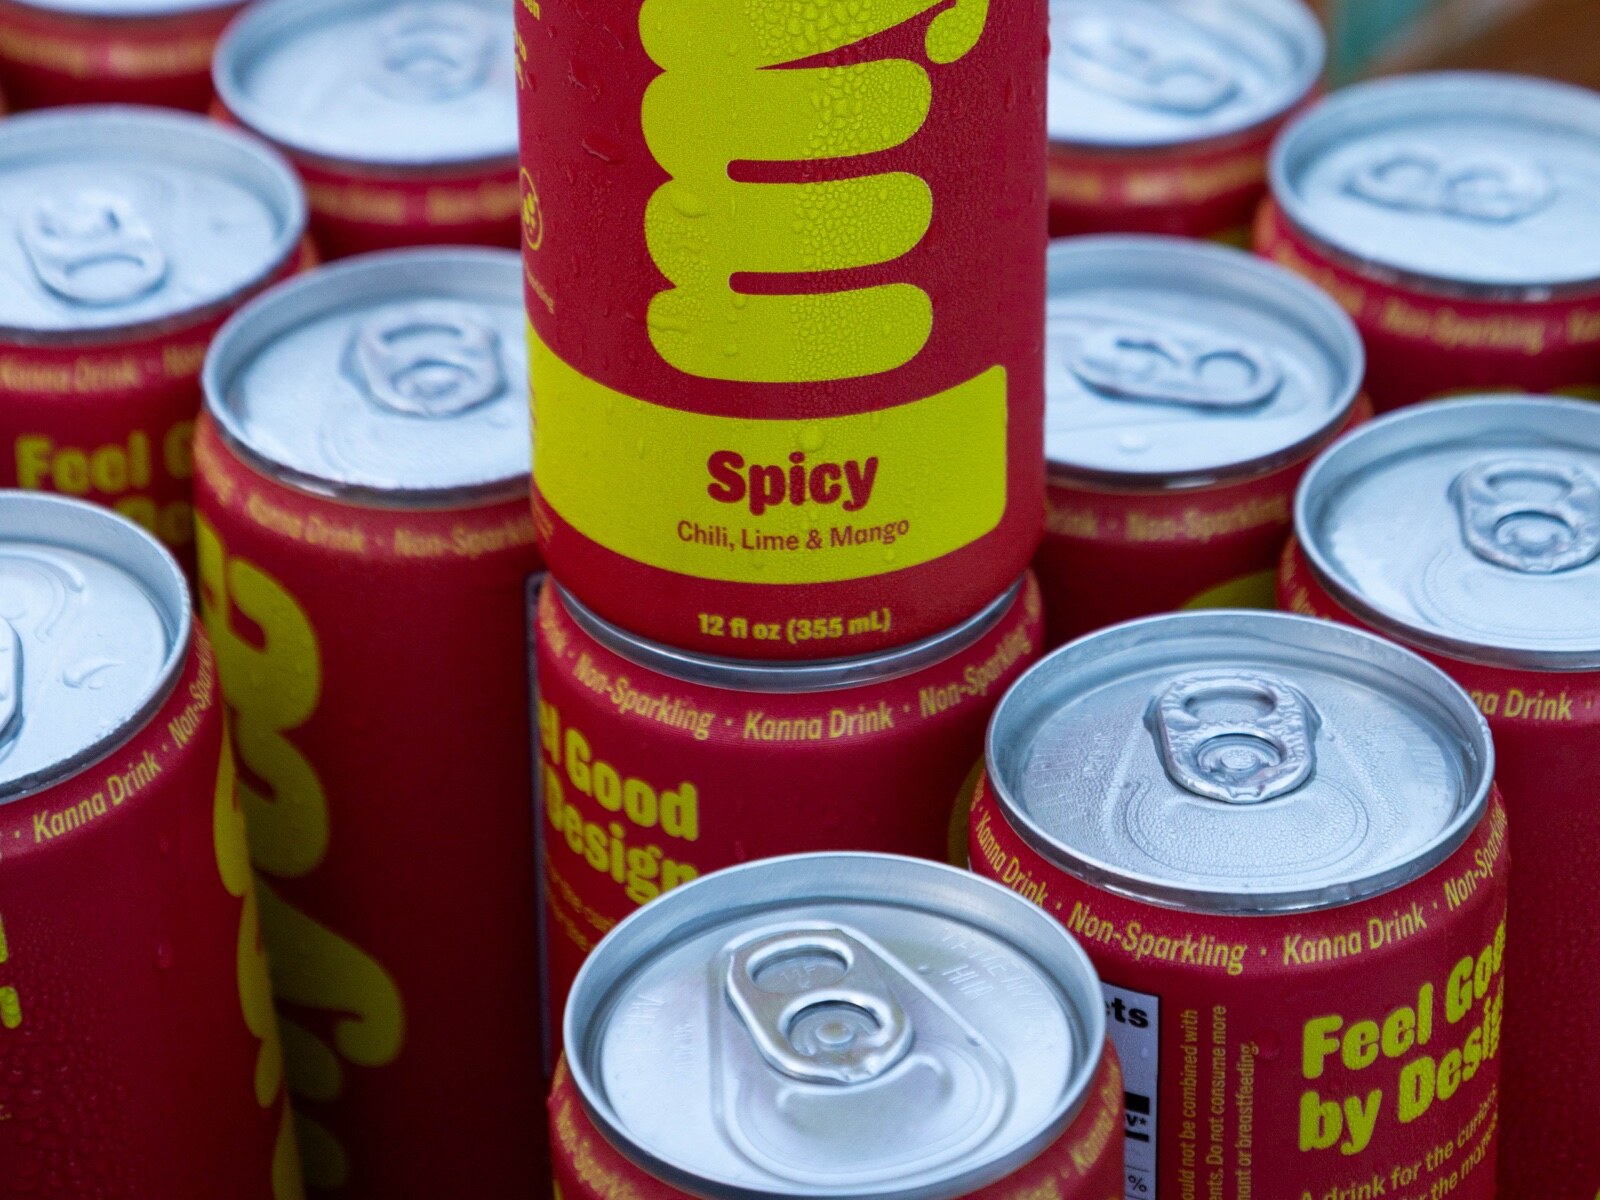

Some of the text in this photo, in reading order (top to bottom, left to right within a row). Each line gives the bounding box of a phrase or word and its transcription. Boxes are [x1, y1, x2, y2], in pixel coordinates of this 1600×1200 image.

[706, 449, 879, 516] Spicy
[677, 519, 911, 552] Chili, Lime & Mango
[698, 607, 893, 645] 12 fl oz (355 mL)
[573, 653, 716, 741] Non-Sparkling
[743, 710, 822, 741] Kanna
[829, 701, 894, 738] Drink
[1504, 687, 1573, 722] Drink
[32, 791, 108, 843] Kanna
[106, 750, 163, 807] Drink
[564, 727, 699, 842] Good
[975, 812, 1008, 873] Kanna
[1001, 855, 1050, 911] Drink
[1067, 901, 1247, 976] Non-Sparkling
[1282, 932, 1363, 967] Kanna
[1367, 901, 1429, 951] Drink
[1180, 1008, 1199, 1044] with
[1211, 1005, 1228, 1045] more
[1302, 981, 1434, 1080] Feel
[1180, 1046, 1198, 1119] combined
[1210, 1047, 1227, 1116] consume
[1234, 1041, 1260, 1149] breastfeeding.
[1180, 1120, 1197, 1140] be
[1208, 1116, 1225, 1143] not
[1298, 1089, 1383, 1156] by
[1181, 1142, 1196, 1168] not
[1205, 1144, 1224, 1166] Do
[1238, 1150, 1252, 1167] or
[1390, 1160, 1423, 1191] for
[1425, 1140, 1454, 1172] the
[1430, 1171, 1459, 1200] the
